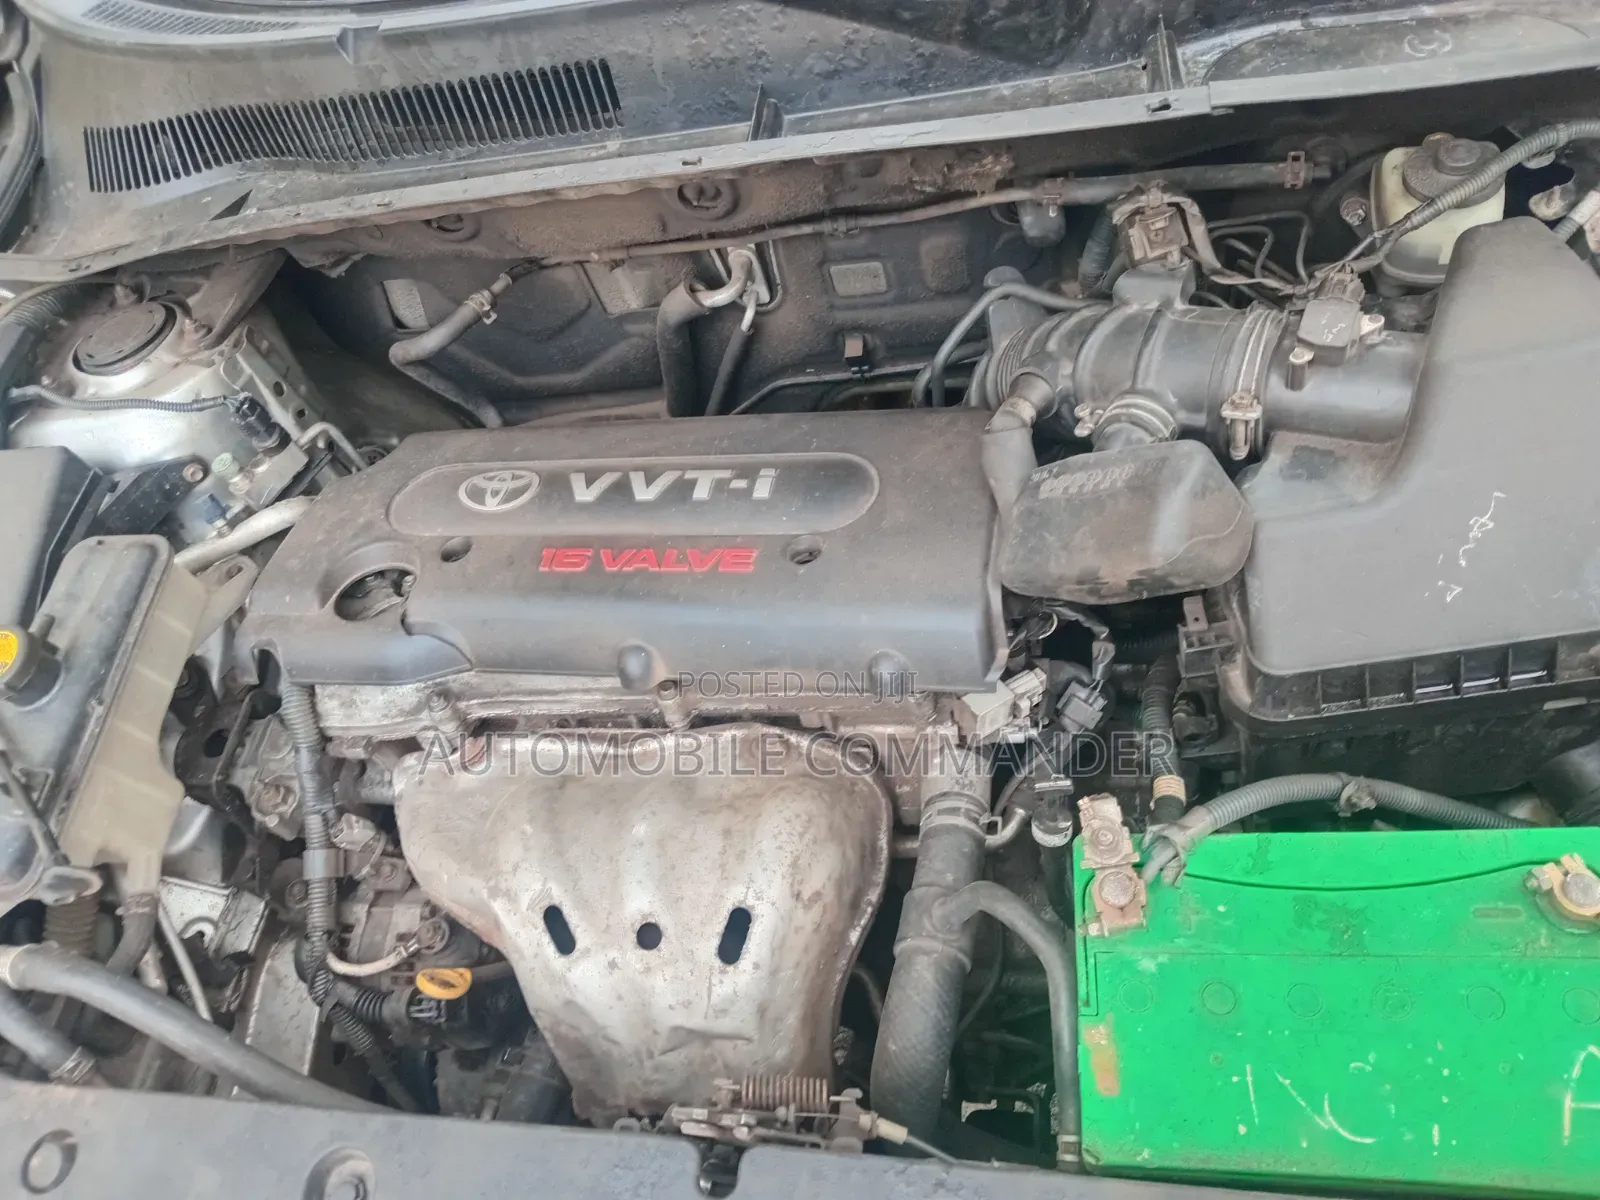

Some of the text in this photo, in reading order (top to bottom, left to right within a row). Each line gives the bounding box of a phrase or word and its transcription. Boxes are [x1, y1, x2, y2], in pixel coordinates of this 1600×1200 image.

[569, 468, 779, 502] VVT-i
[539, 548, 758, 573] 16 VALVE
